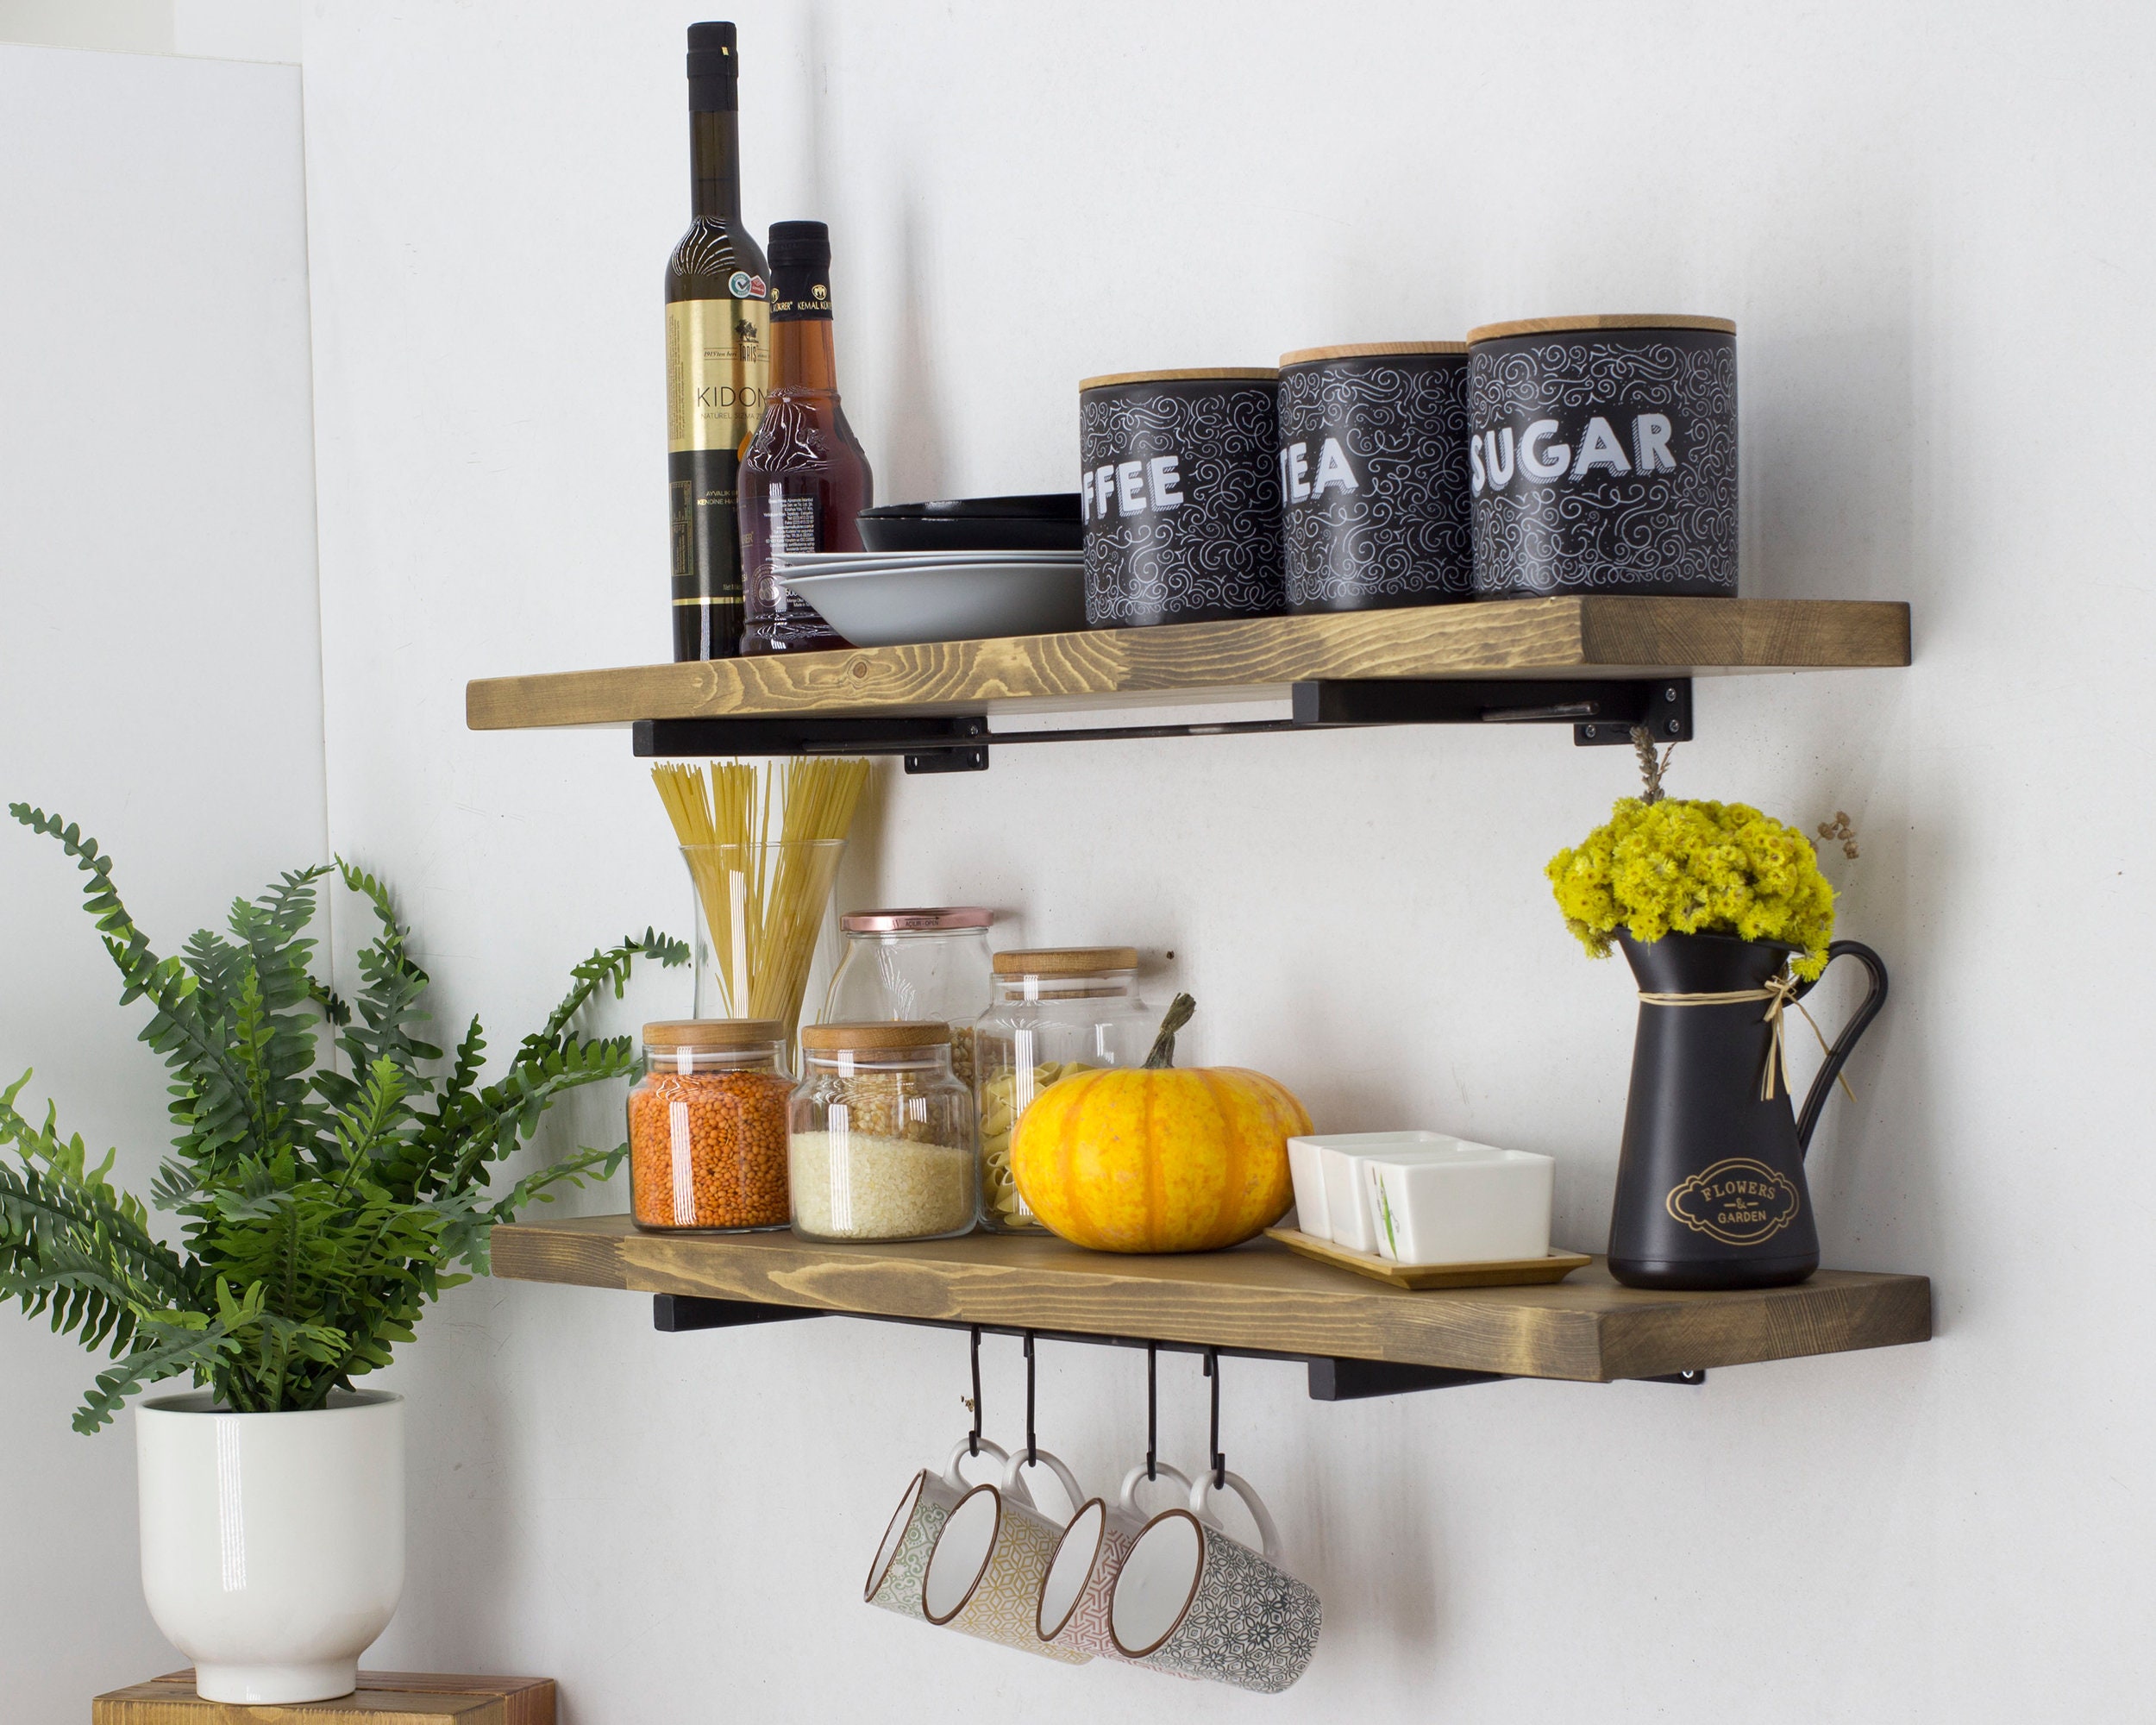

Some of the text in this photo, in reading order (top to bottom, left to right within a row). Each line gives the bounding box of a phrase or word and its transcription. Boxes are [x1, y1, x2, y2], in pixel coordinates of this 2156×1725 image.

[797, 301, 819, 310] KEMAL
[1470, 413, 1677, 498] SUGAR
[1701, 1181, 1777, 1201] FLOWERS
[1717, 1210, 1767, 1224] GARDEN
